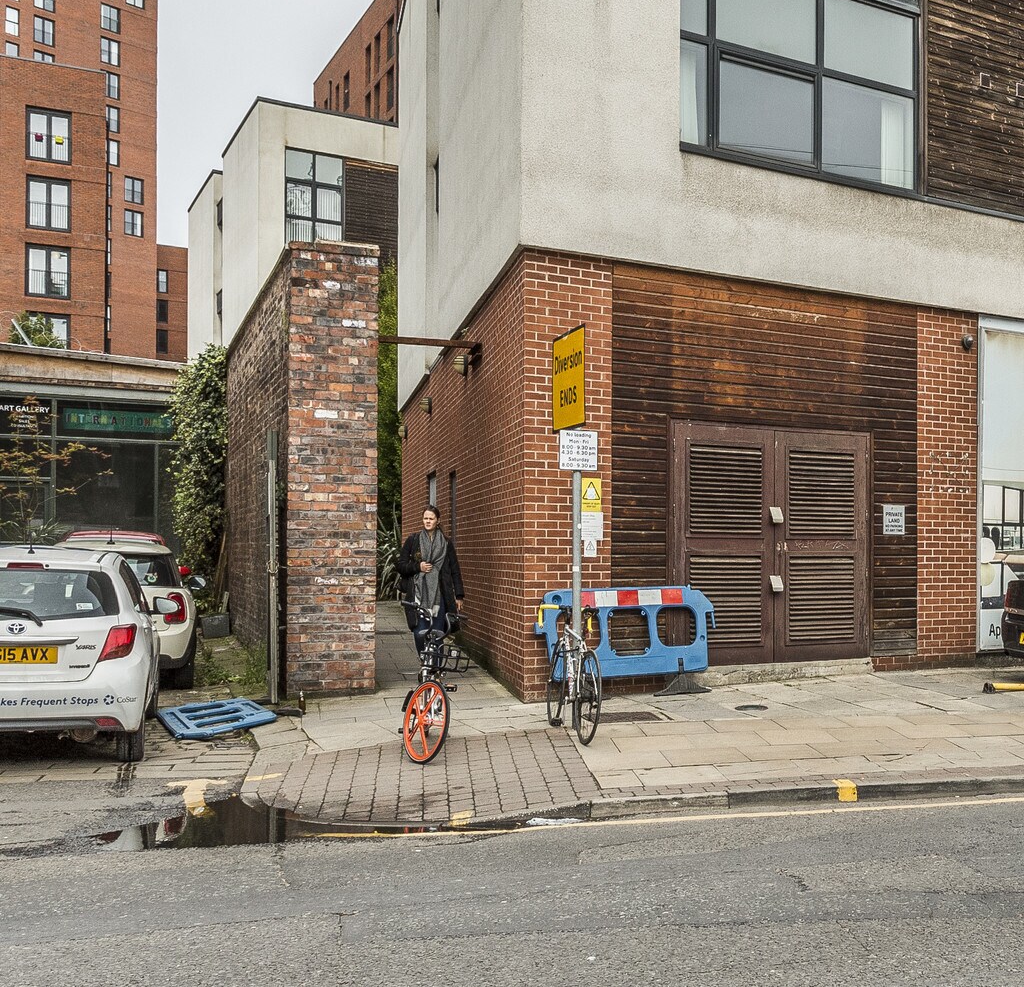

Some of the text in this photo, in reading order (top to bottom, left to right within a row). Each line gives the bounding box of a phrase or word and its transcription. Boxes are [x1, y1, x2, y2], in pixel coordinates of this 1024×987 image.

[555, 349, 582, 375] Diversion
[560, 385, 577, 407] ENDS
[20, 648, 48, 661] AVX
[20, 697, 68, 708] Frequent
[70, 696, 98, 706] Stops
